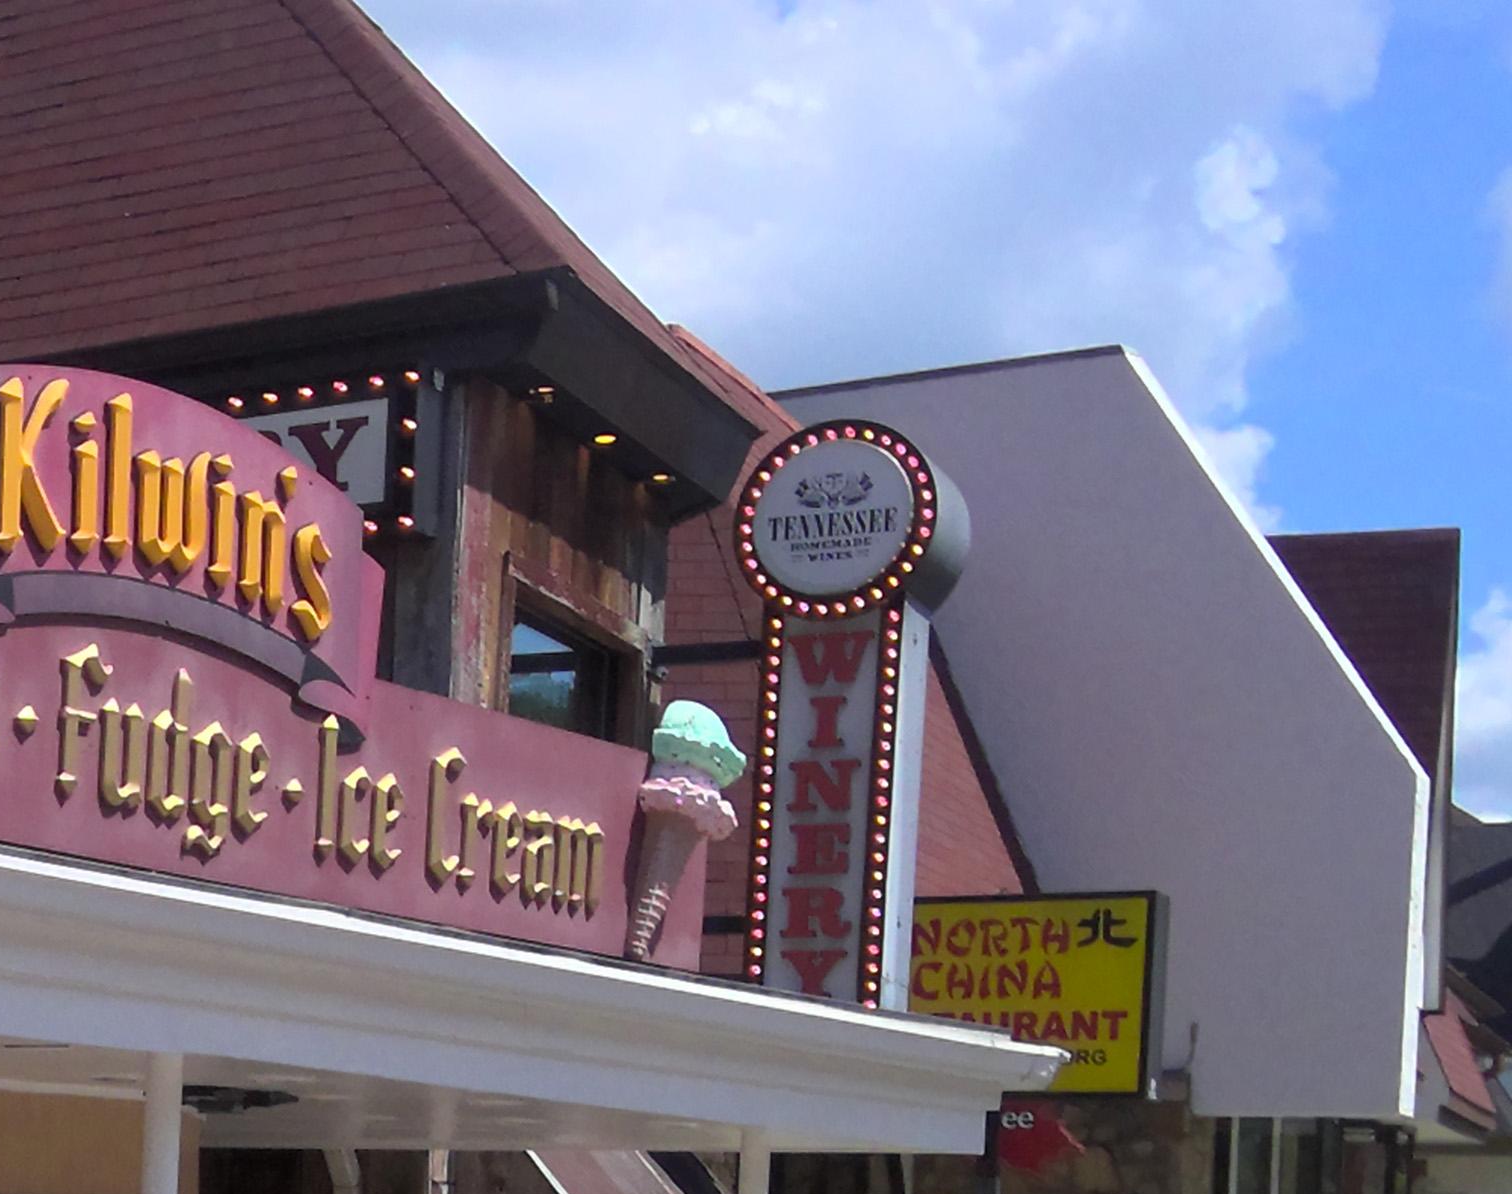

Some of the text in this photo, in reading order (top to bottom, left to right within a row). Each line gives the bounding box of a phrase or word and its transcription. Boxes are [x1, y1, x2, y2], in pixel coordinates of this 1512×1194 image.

[768, 507, 898, 541] TENNESSEE
[790, 537, 872, 553] HOMEMADE
[807, 550, 854, 562] WINES
[58, 643, 269, 857] Fudge
[316, 713, 405, 869] Ice
[427, 746, 605, 916] Cream
[779, 629, 876, 998] WINERY
[912, 917, 1070, 957] NORTH
[912, 959, 1062, 1001] CHINA
